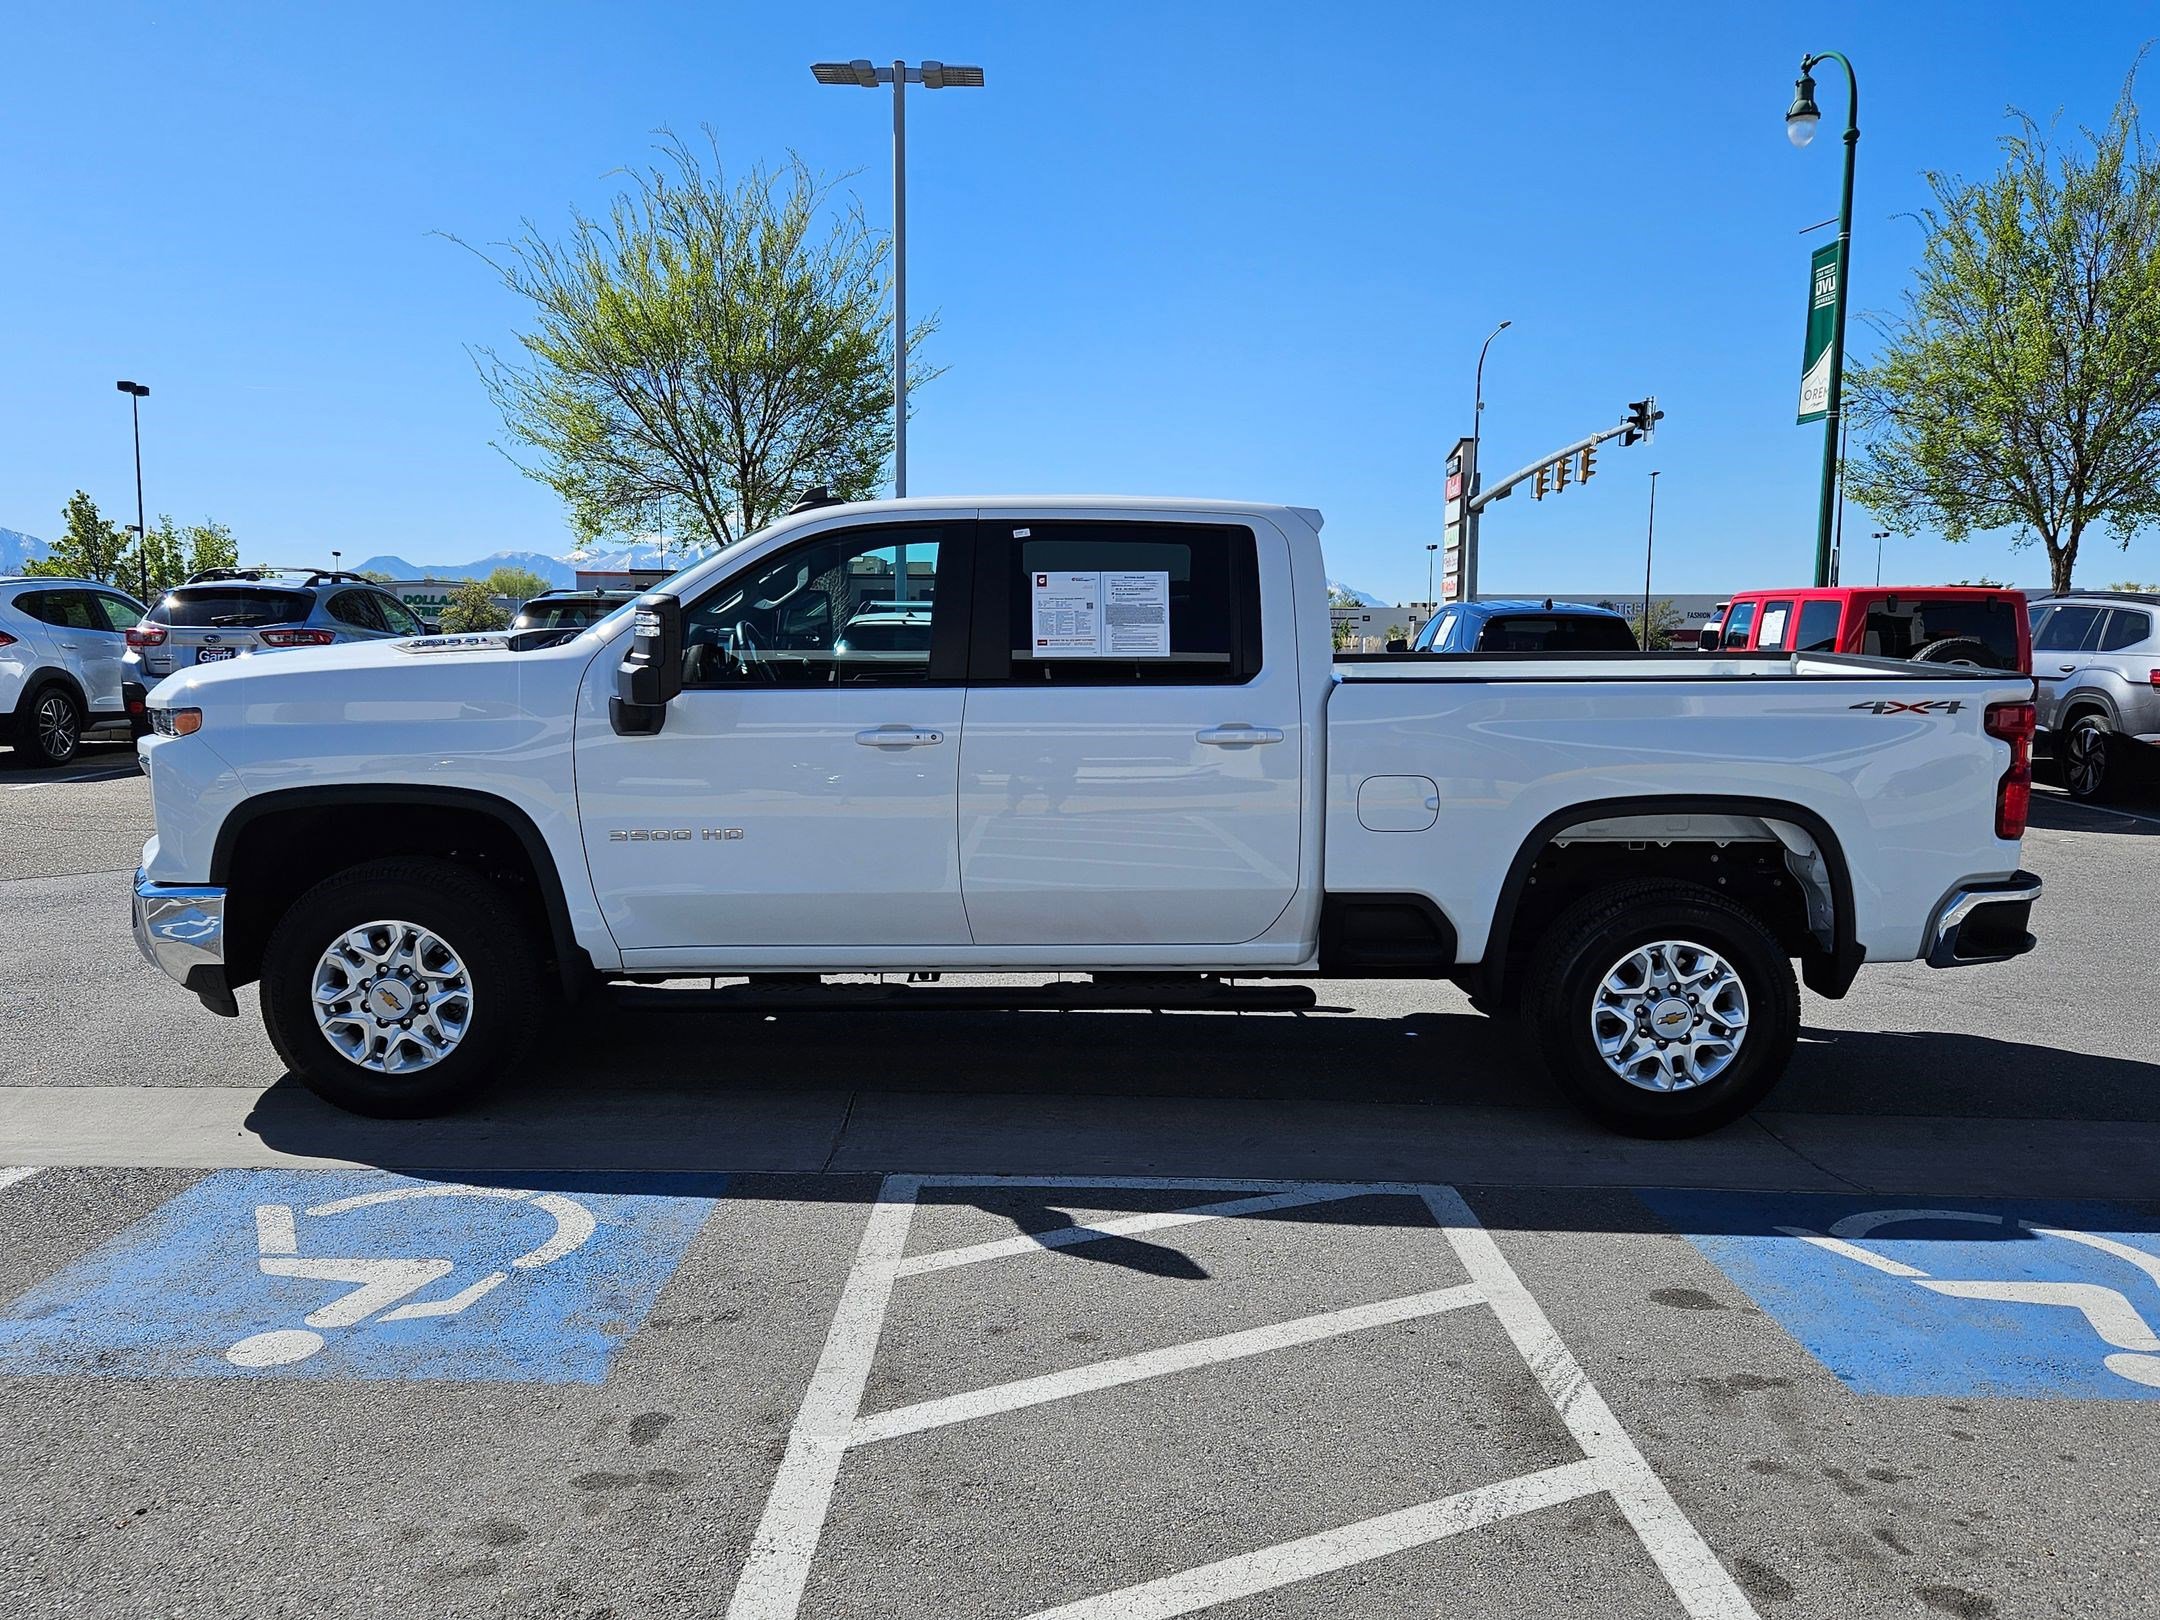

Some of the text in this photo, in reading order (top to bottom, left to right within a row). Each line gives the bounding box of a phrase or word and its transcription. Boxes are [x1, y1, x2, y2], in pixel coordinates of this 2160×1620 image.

[1815, 275, 1836, 297] UVU
[1687, 611, 1711, 619] FASHION
[198, 650, 233, 662] Garff
[608, 828, 744, 841] 3500 HD
